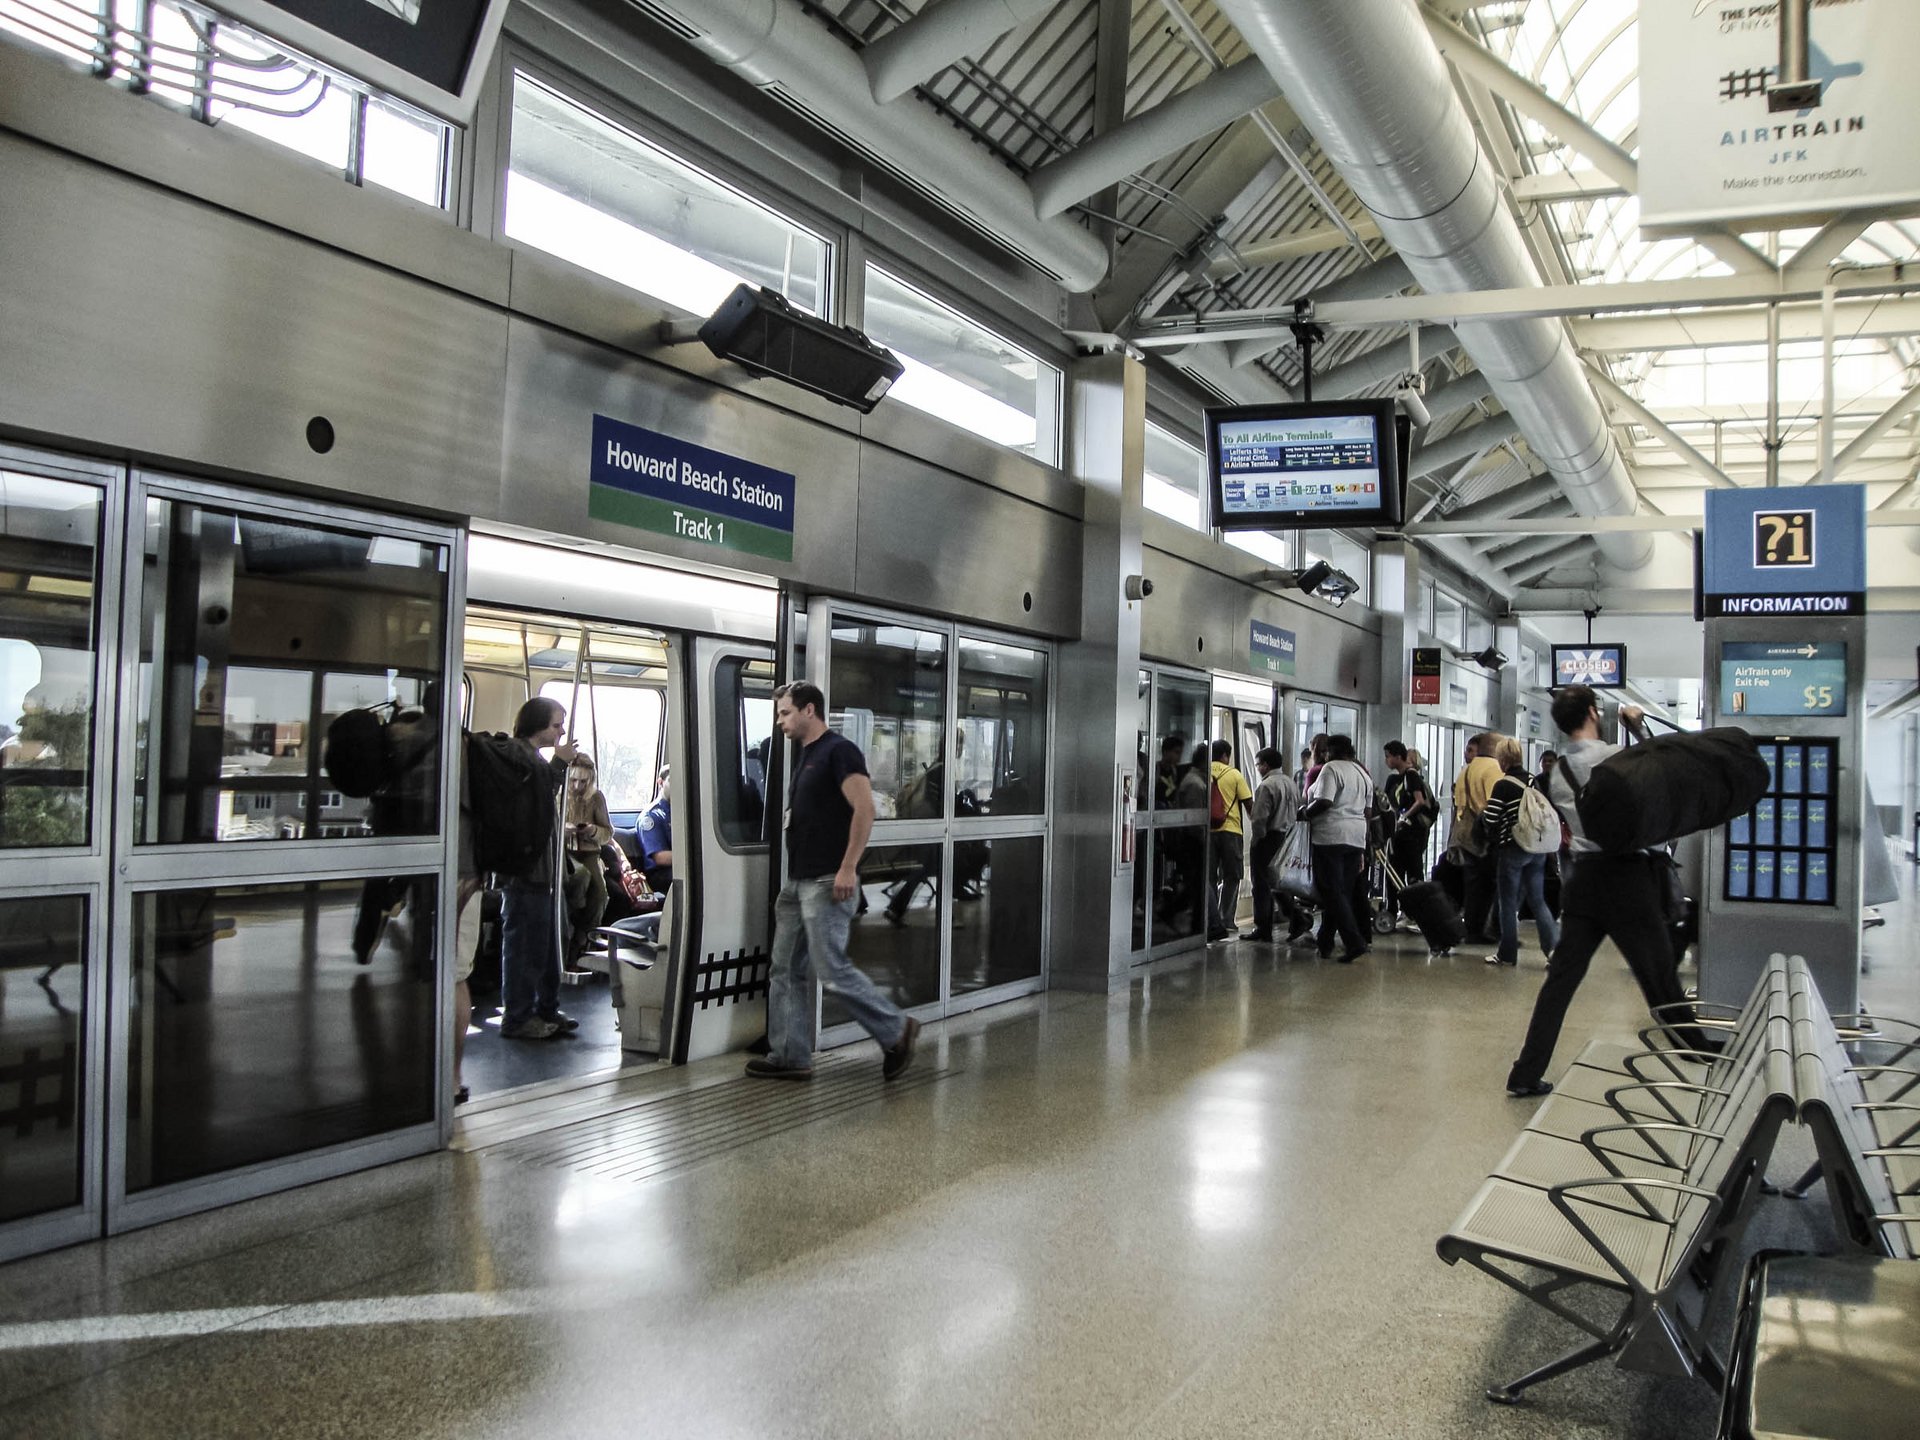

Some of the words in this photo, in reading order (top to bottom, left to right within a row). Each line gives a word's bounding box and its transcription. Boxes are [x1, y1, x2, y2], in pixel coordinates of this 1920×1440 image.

[1720, 8, 1745, 21] THE
[1720, 116, 1864, 146] AIRTRAIN
[1769, 149, 1808, 164] JFK
[1723, 178, 1759, 190] Make
[1763, 175, 1784, 186] the
[1788, 167, 1867, 184] connection.
[1223, 434, 1234, 444] To
[1237, 433, 1249, 443] All
[1252, 432, 1284, 443] Airline
[1285, 430, 1333, 441] Terminals
[607, 440, 677, 482] Howard
[682, 461, 727, 496] Beach
[732, 477, 783, 512] Station
[673, 511, 712, 541] Track
[717, 523, 724, 543] 1
[1722, 597, 1847, 612] INFORMATION
[1253, 630, 1269, 646] Howard
[1270, 634, 1280, 648] Beach
[1281, 638, 1294, 652] Station
[1565, 660, 1610, 670] CLOSED
[1735, 667, 1769, 676] AirTrain
[1771, 667, 1792, 678] only
[1735, 678, 1752, 686] Exit
[1754, 678, 1769, 687] Fee
[1803, 684, 1833, 710] $5
